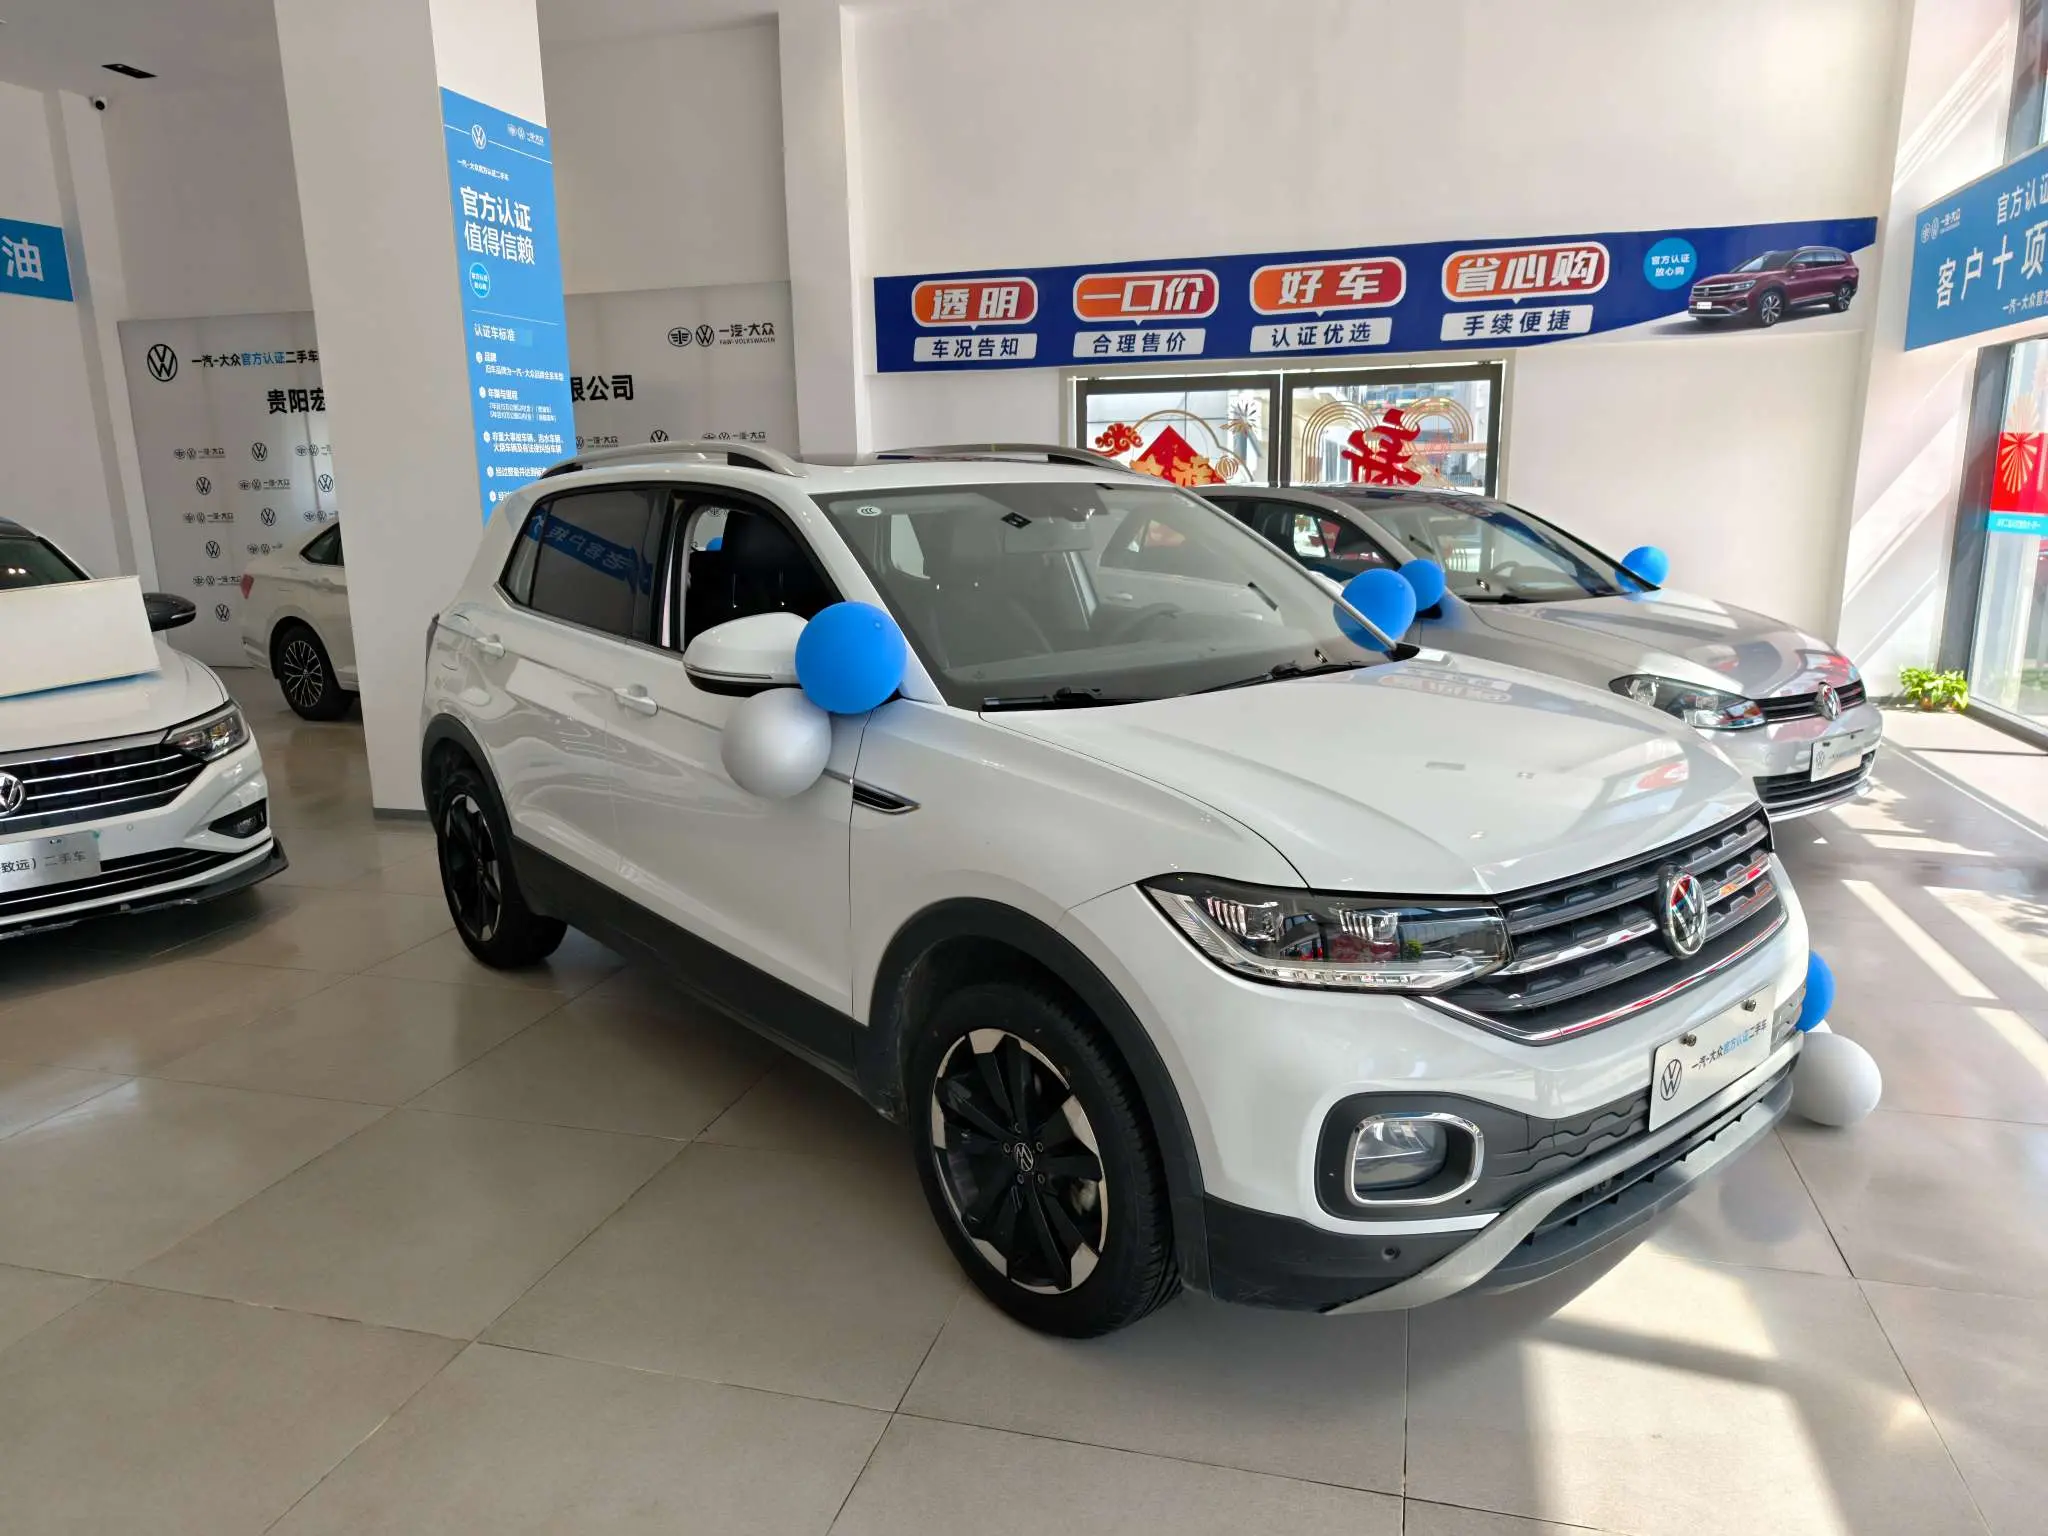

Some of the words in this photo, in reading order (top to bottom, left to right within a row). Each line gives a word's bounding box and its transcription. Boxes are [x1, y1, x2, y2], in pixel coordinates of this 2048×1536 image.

[460, 186, 533, 232] 官方认证
[2, 236, 44, 281] 油
[463, 221, 536, 265] 值得信赖
[1651, 254, 1690, 265] 官方认证
[1456, 249, 1600, 293] 省心购
[1936, 220, 2048, 310] 客户十项
[931, 286, 1020, 320] 透明
[1083, 277, 1204, 313] 一口价
[1278, 266, 1383, 305] 好车
[474, 323, 516, 342] 认证车标准
[1271, 320, 1374, 347] 认证优选
[1463, 309, 1572, 336] 手续便捷
[932, 338, 1019, 358] 车况告知
[1092, 332, 1186, 354] 合理售价
